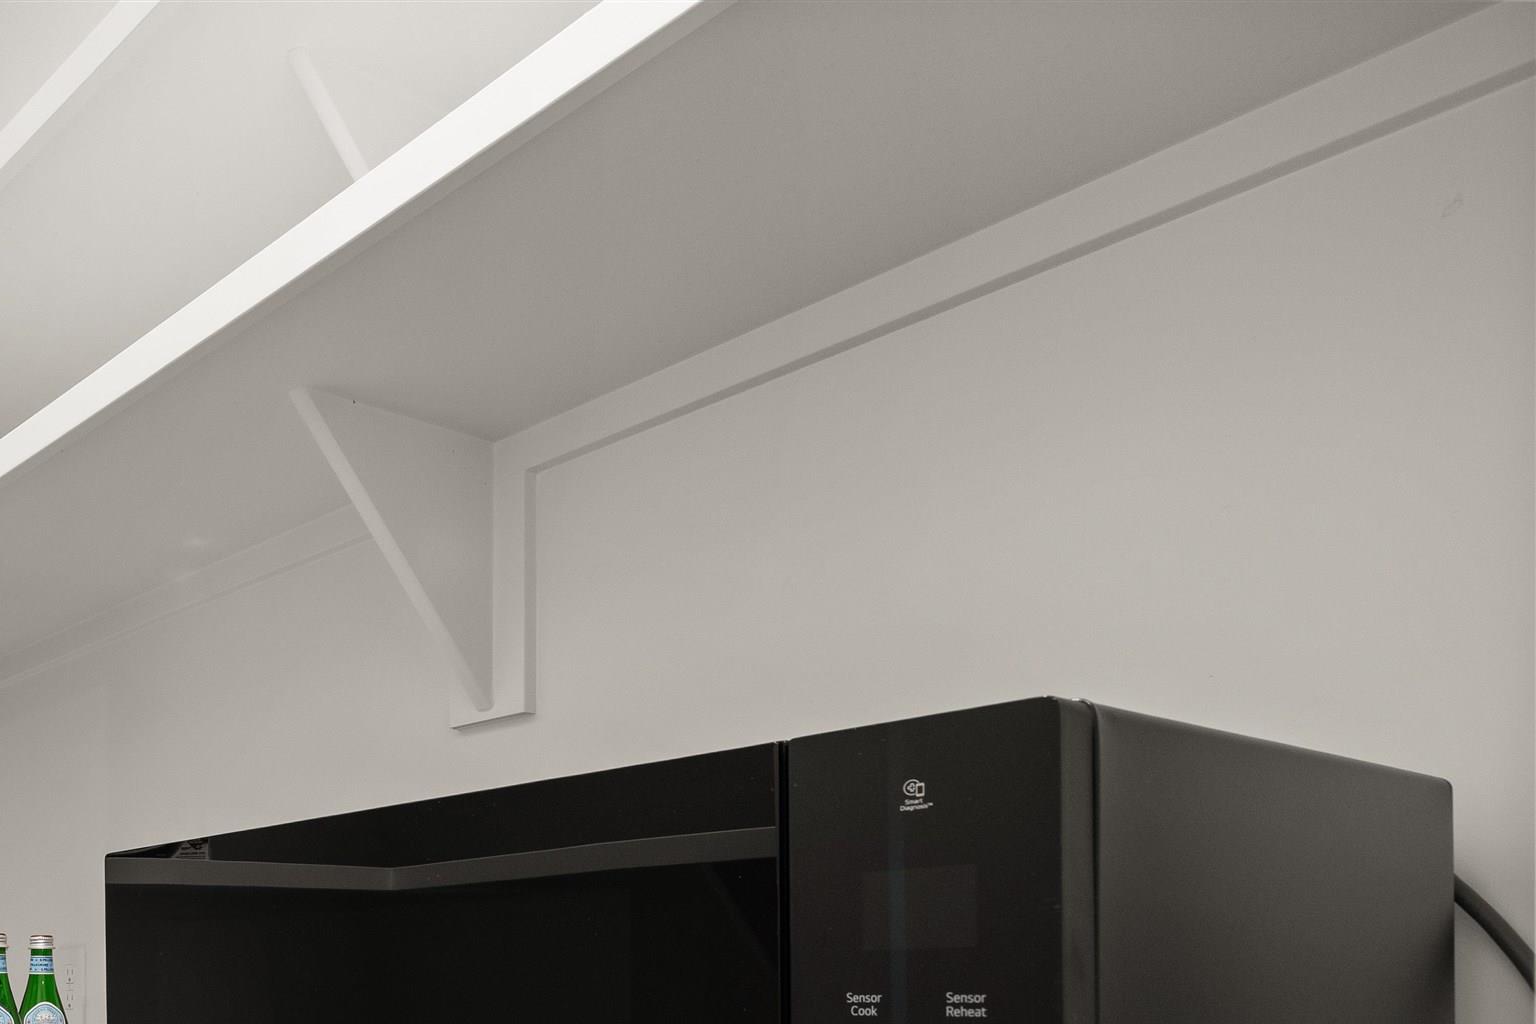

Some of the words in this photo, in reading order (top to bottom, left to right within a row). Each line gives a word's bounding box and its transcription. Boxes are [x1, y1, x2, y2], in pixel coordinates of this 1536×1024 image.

[846, 991, 883, 1004] Sensor
[945, 991, 987, 1004] Sensor
[850, 1005, 878, 1017] Cook
[945, 1005, 988, 1018] Reheat
